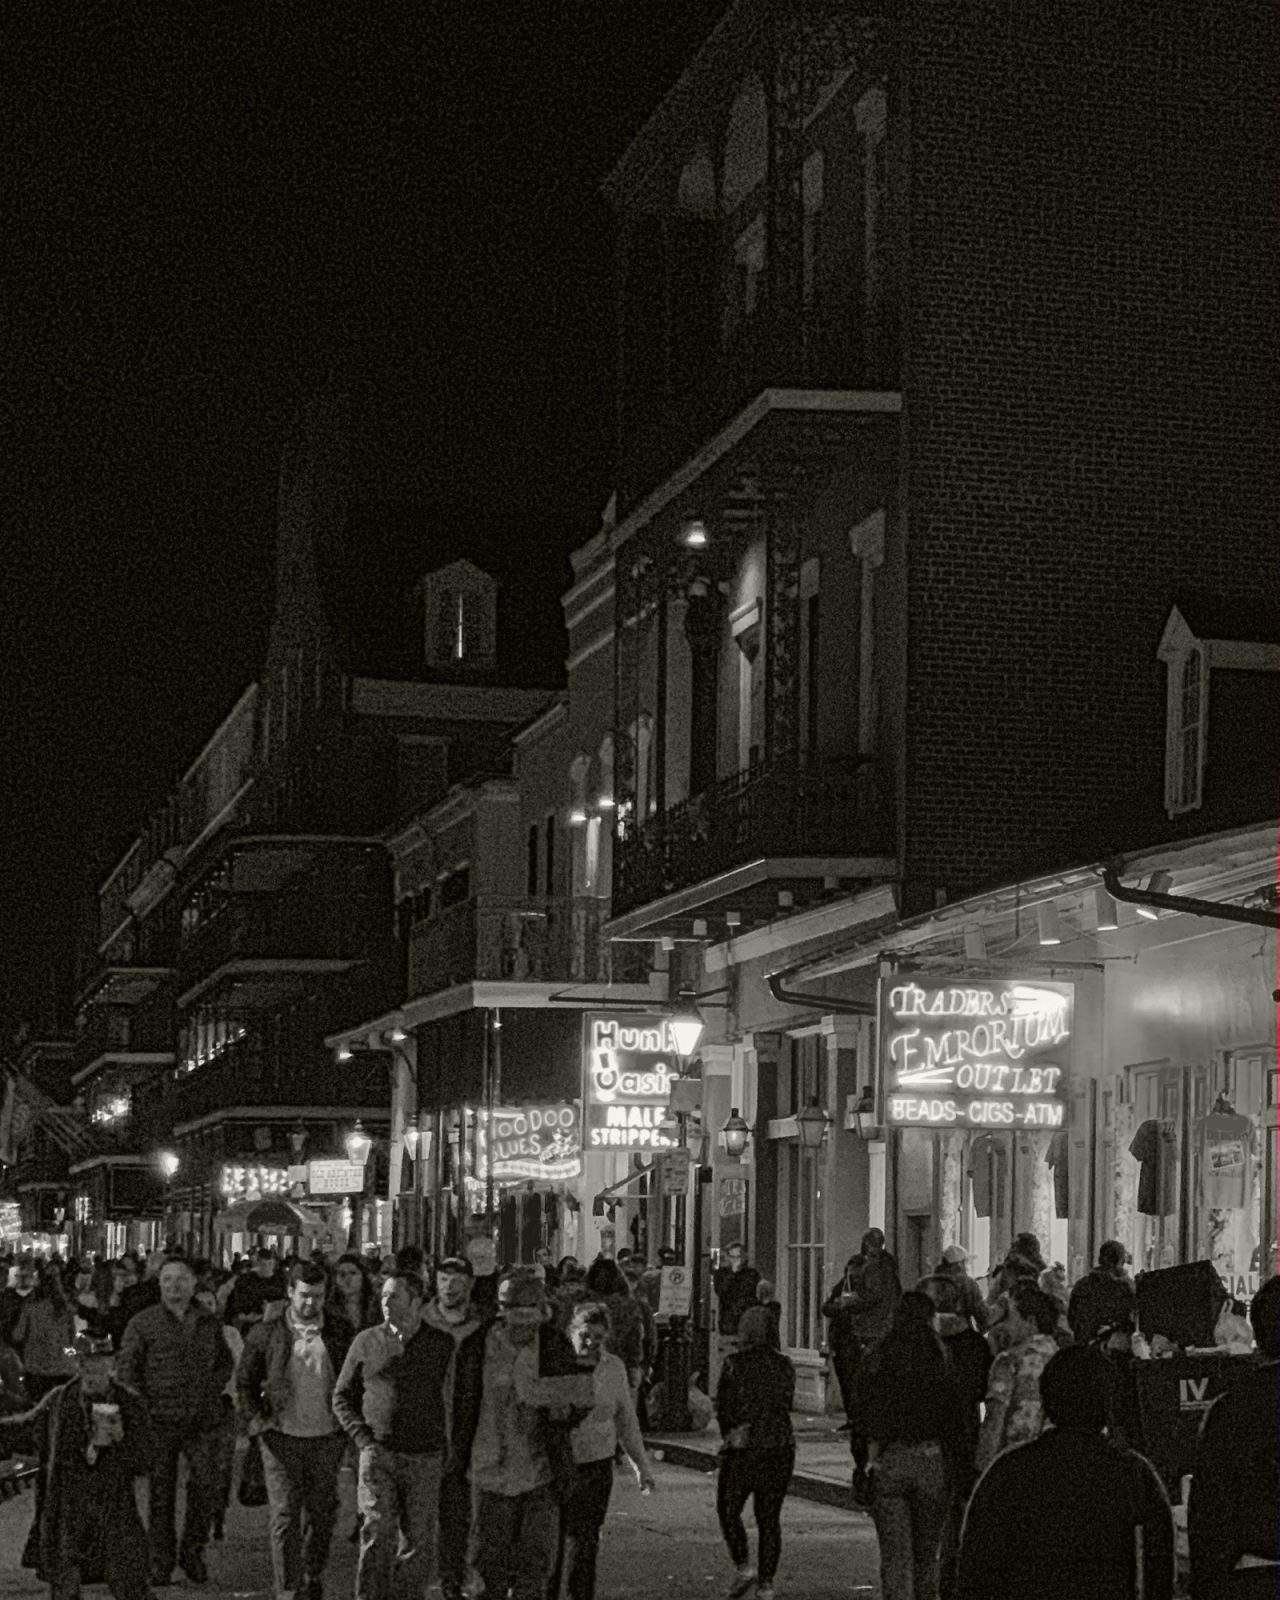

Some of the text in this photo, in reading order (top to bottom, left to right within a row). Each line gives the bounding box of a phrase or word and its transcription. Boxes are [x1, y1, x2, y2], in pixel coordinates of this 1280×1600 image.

[890, 982, 1011, 1016] TRADERS
[890, 1009, 1070, 1075] EMPORIUM
[957, 1064, 1061, 1093] OUTLET
